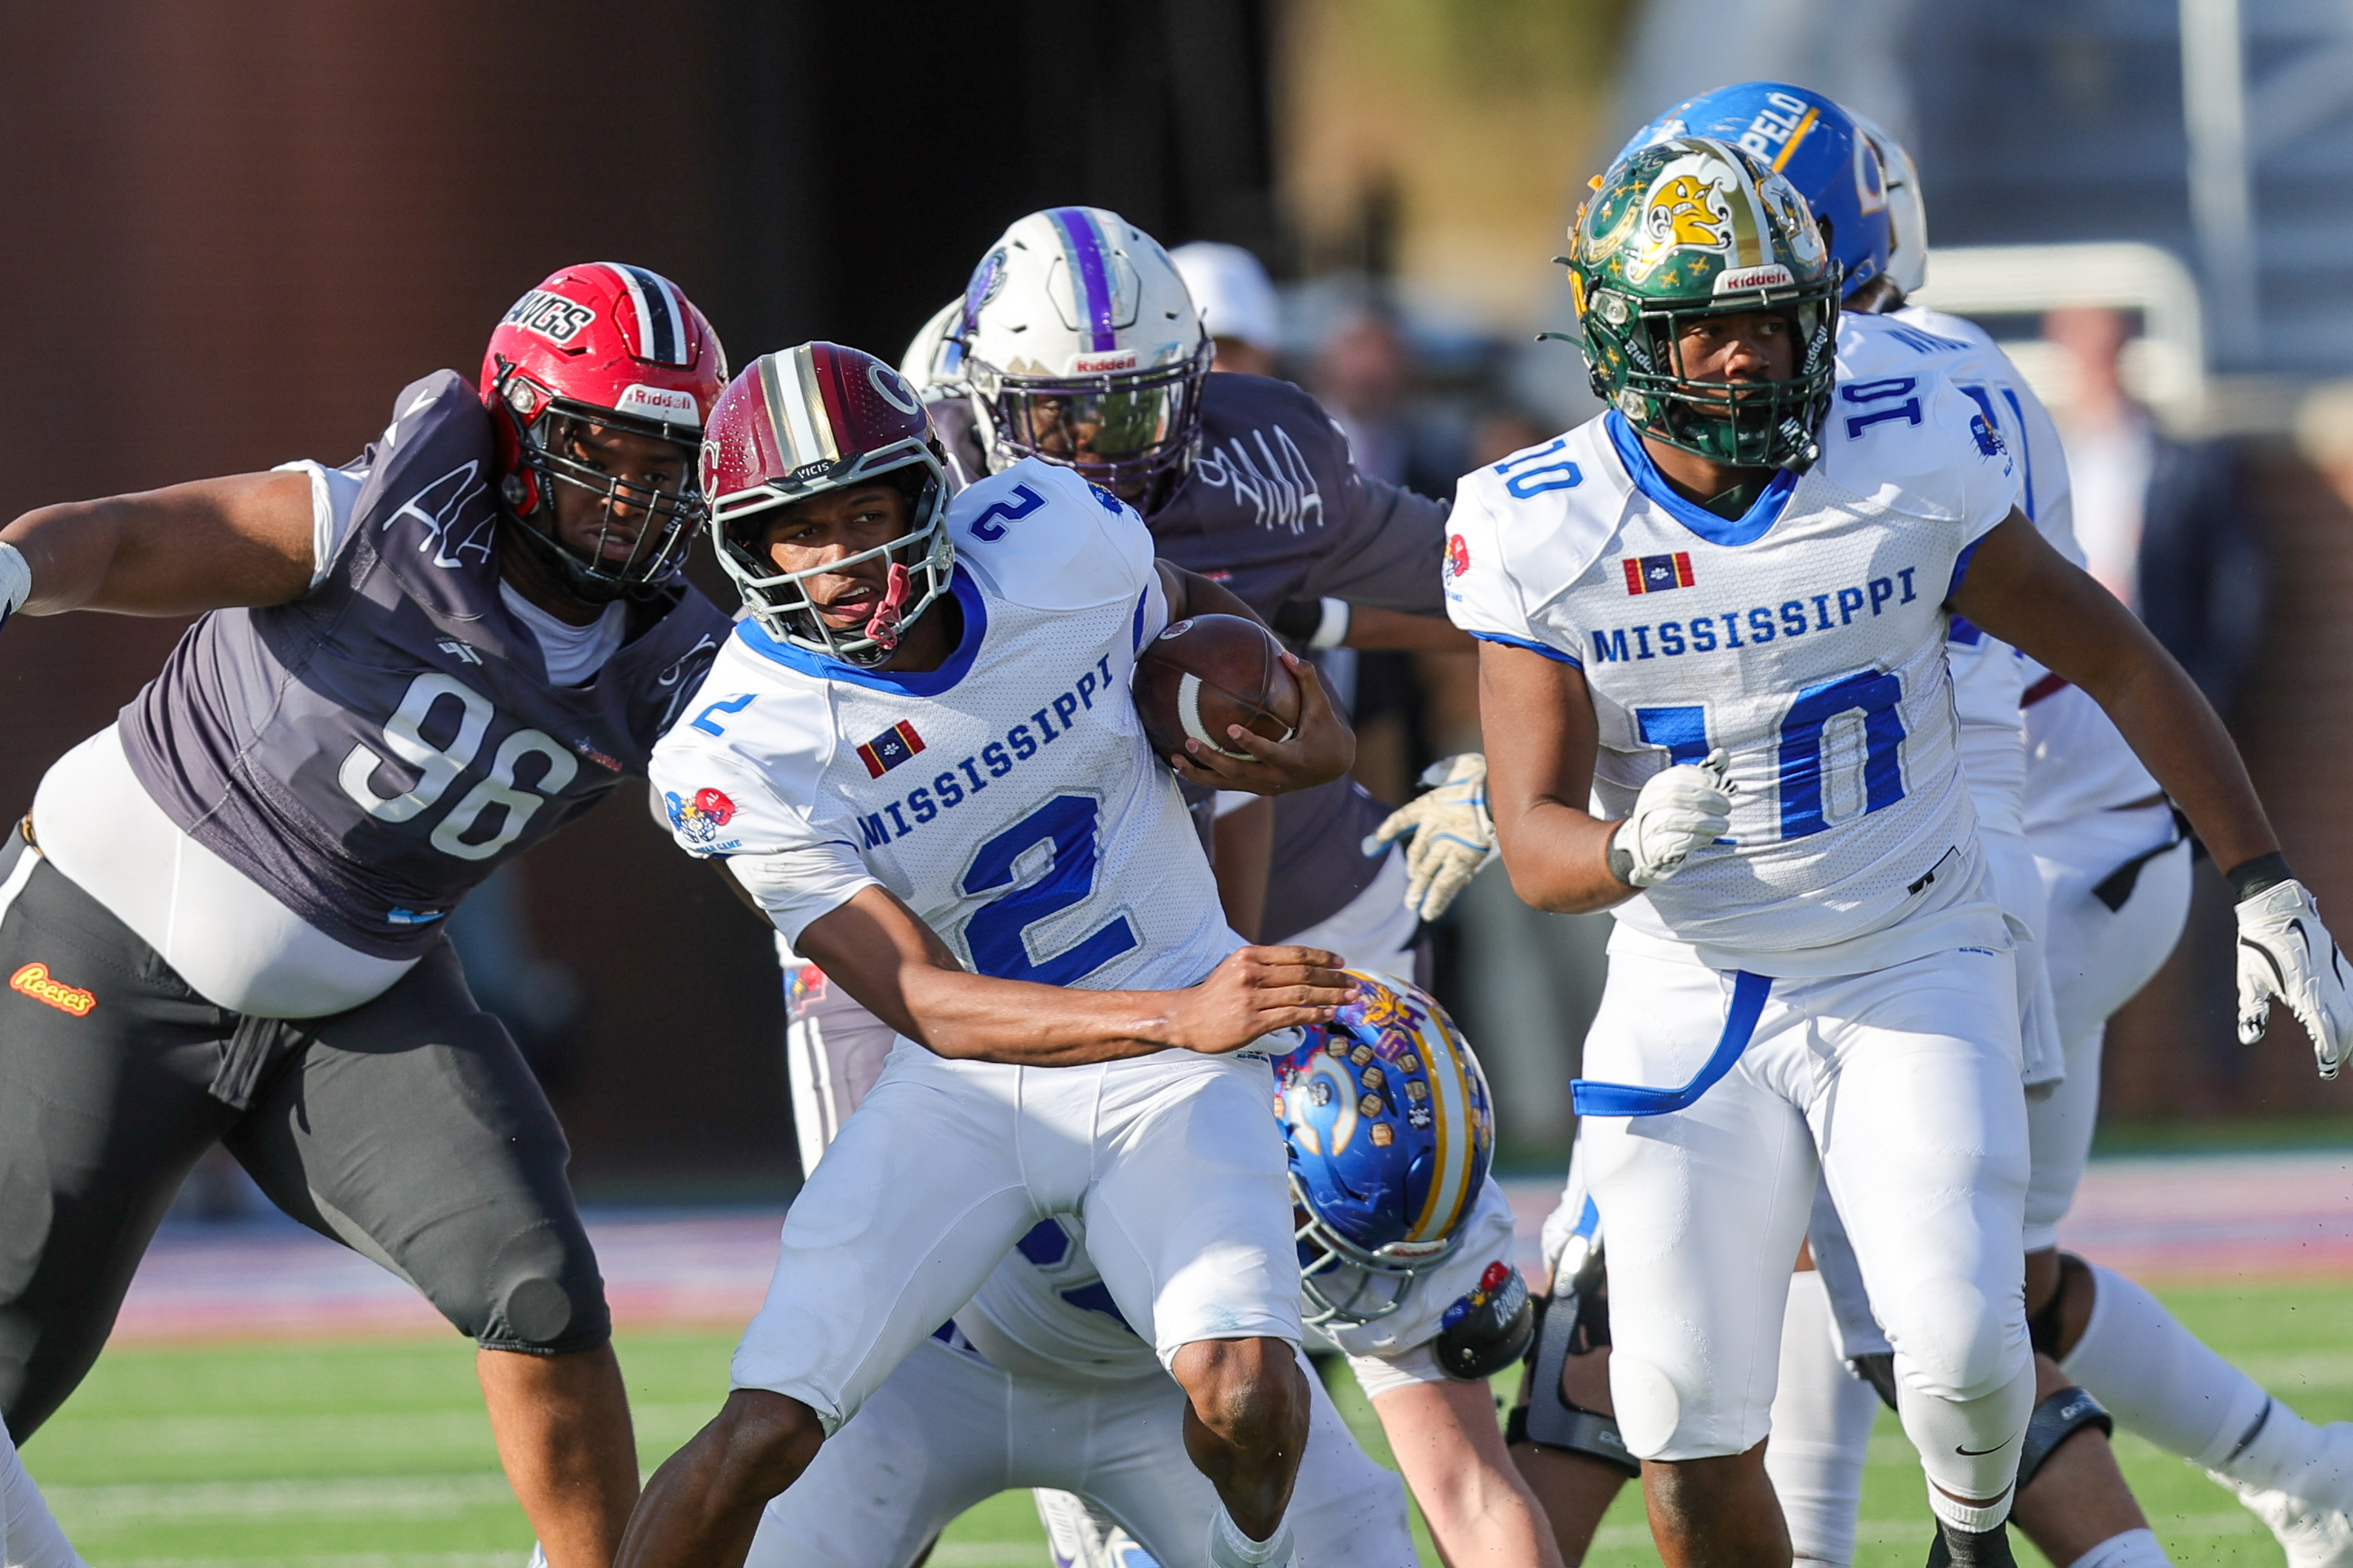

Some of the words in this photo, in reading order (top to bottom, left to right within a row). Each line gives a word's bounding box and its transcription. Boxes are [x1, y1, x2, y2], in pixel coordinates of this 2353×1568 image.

[1727, 273, 1786, 288] Riddell
[1078, 357, 1136, 372] Riddell
[635, 388, 691, 409] Riddell
[1841, 377, 1921, 439] 10
[797, 461, 830, 479] VICIS
[1493, 439, 1583, 500] 10
[970, 484, 1045, 541] 2
[1592, 566, 1917, 663] MISSISSIPPI
[856, 652, 1113, 851] MISSISSIPPI
[962, 794, 1138, 988] 2
[14, 967, 92, 1012] Reese's
